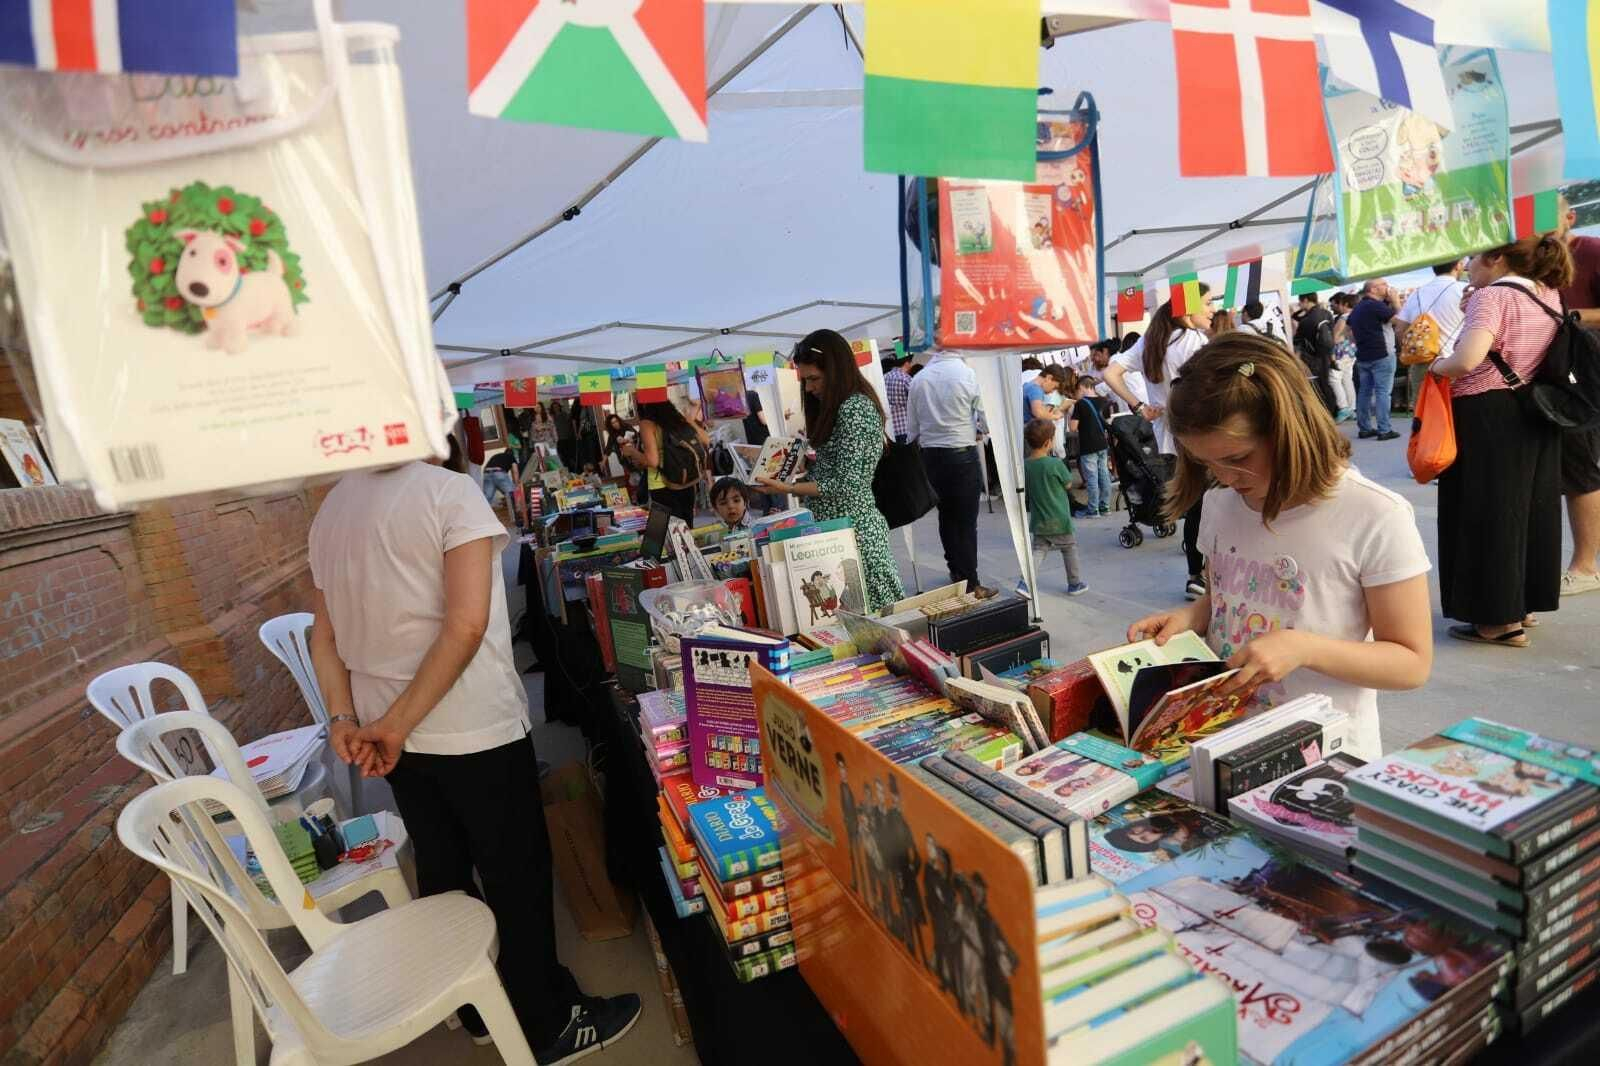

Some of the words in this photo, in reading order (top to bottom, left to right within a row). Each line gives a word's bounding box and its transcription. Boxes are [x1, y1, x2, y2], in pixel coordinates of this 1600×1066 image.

[790, 541, 845, 562] Leonardo
[765, 720, 824, 799] VERNE
[1368, 772, 1440, 799] CRAZY
[1444, 798, 1491, 818] THE
[704, 811, 735, 842] DIARIO
